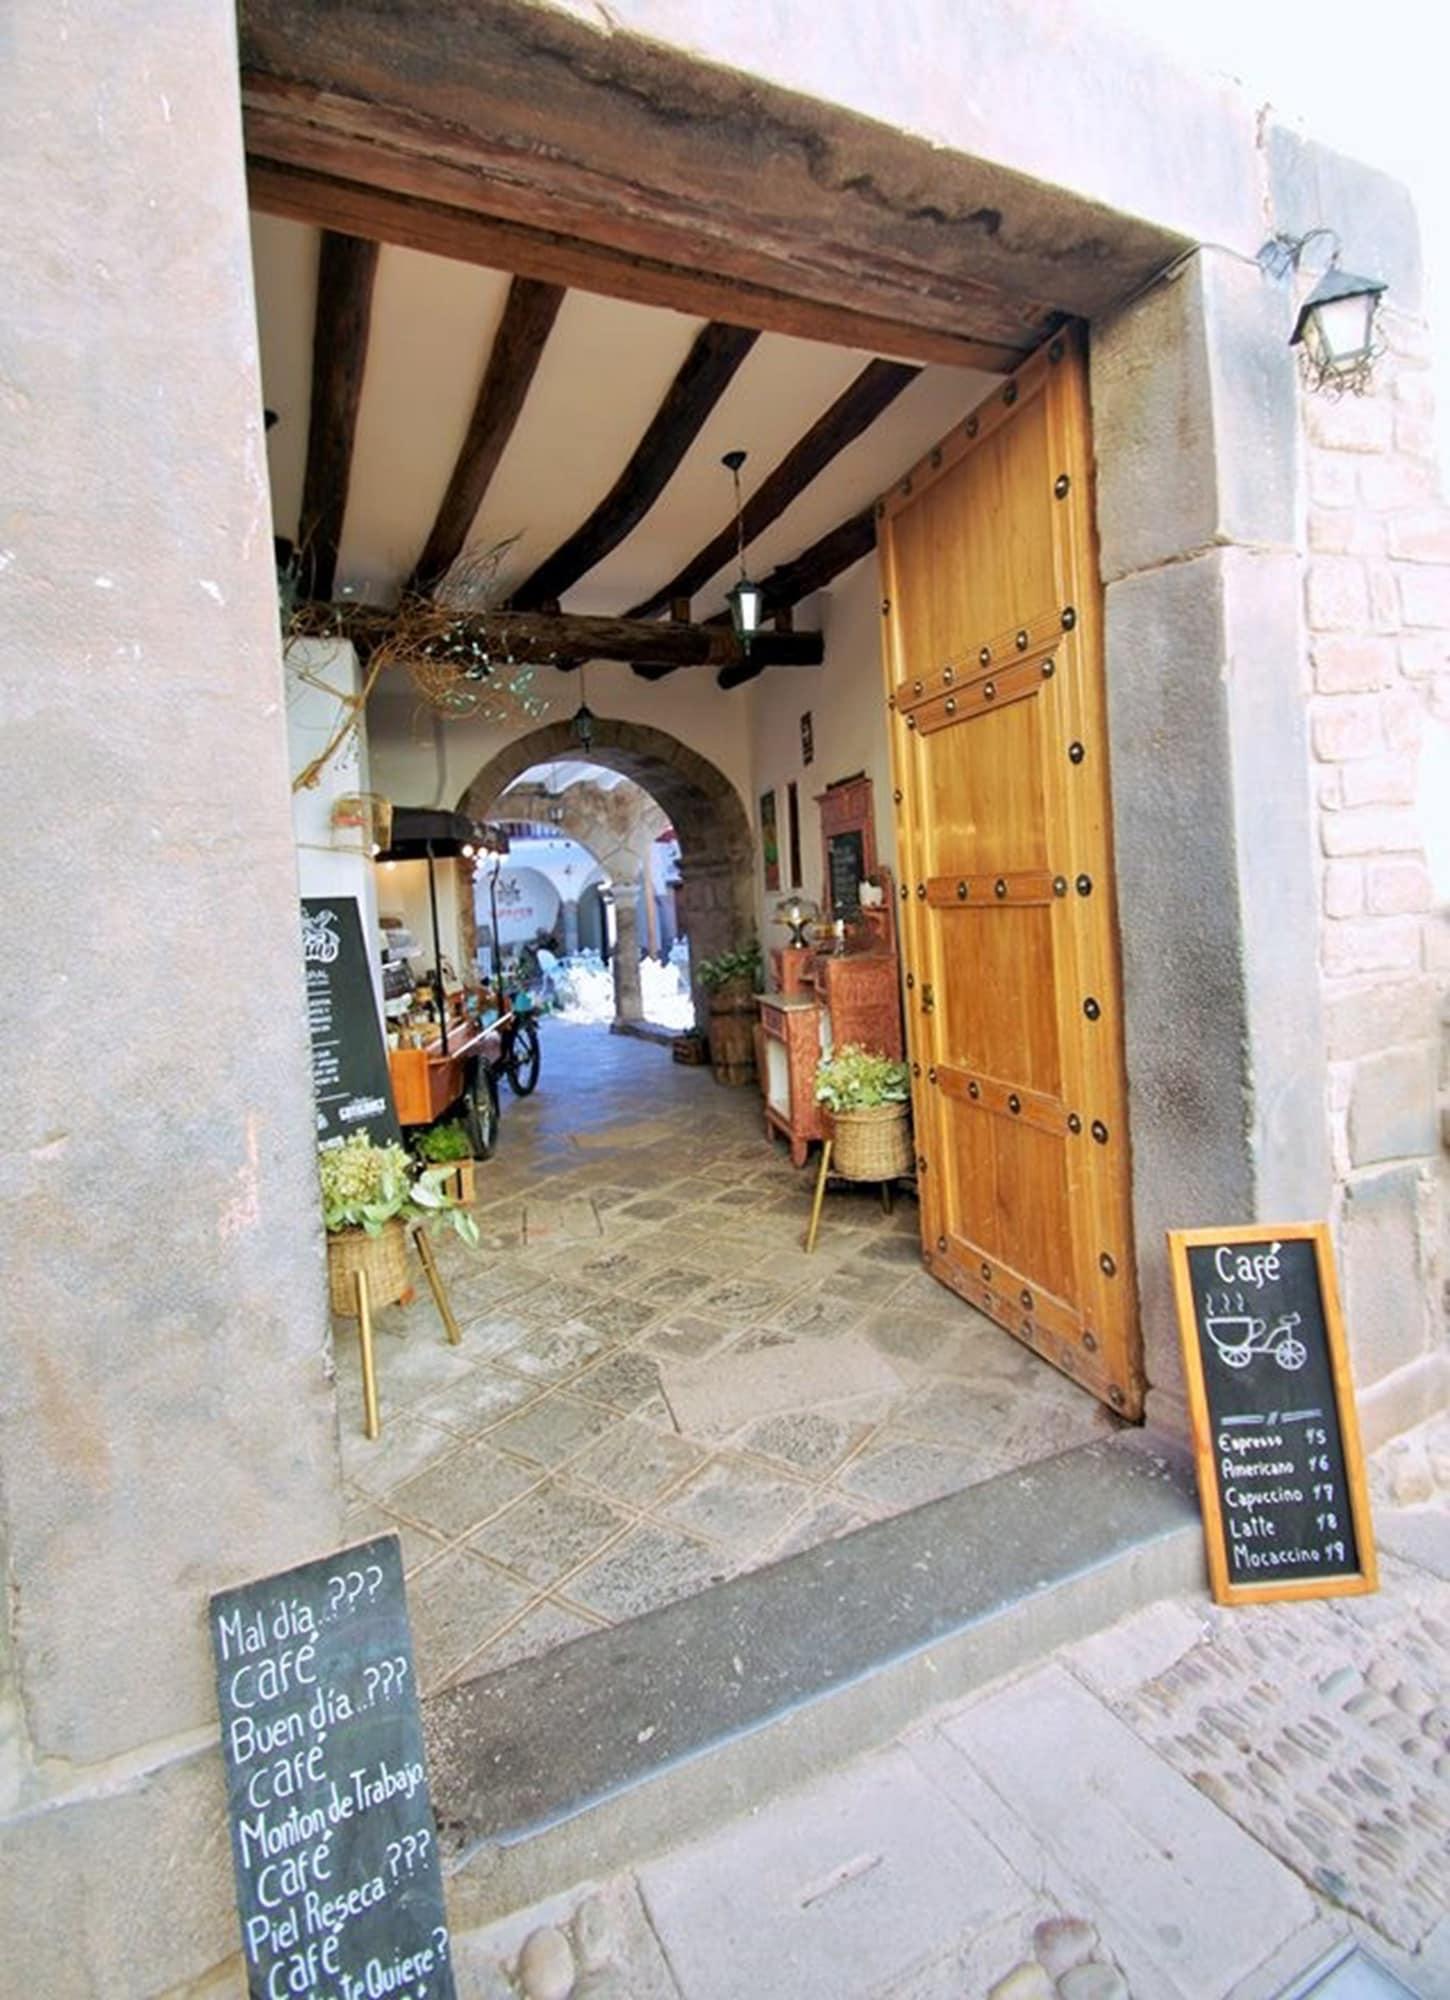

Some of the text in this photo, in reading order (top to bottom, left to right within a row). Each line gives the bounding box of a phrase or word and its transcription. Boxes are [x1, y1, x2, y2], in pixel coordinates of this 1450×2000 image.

[1215, 1242, 1282, 1289] Café
[1221, 1458, 1295, 1479] Americano
[1225, 1486, 1303, 1513] Capuccino
[1229, 1515, 1276, 1538] Latte
[1233, 1543, 1320, 1569] Mocaccino
[218, 1608, 267, 1660] Mal
[231, 1716, 304, 1765] Buen
[239, 1806, 326, 1869] Monton
[328, 1781, 354, 1823] de
[247, 1907, 300, 1964] Piel
[304, 1876, 386, 1934] Reseca
